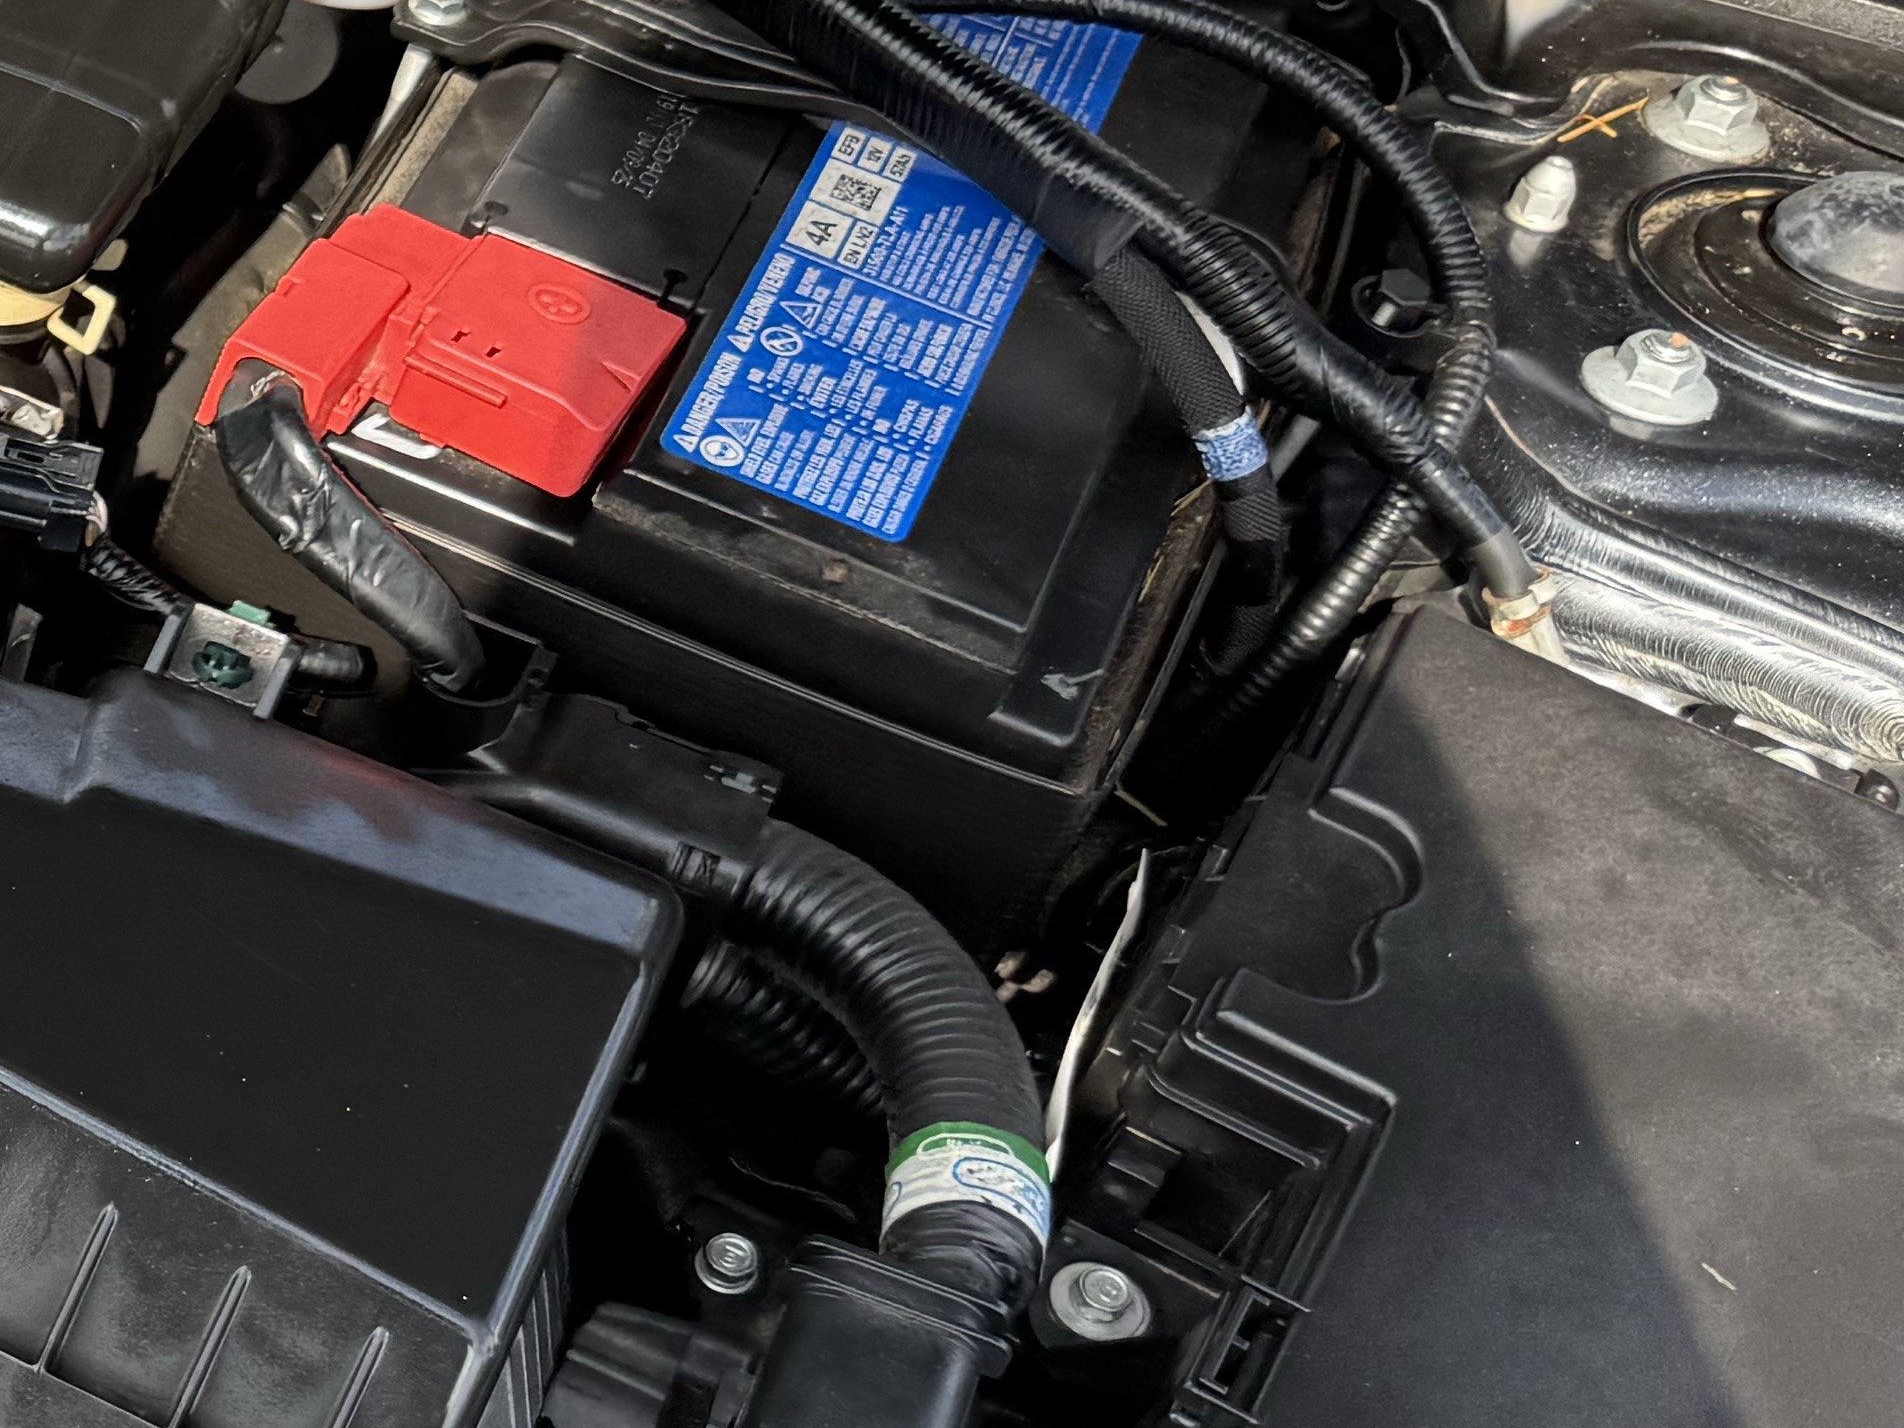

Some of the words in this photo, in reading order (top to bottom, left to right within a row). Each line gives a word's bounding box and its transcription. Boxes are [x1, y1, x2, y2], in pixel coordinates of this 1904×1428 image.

[837, 133, 860, 156] EFB
[800, 214, 838, 248] 4A
[843, 248, 862, 265] EN
[679, 351, 743, 436] DANGER/POISON
[733, 251, 798, 337] PELIGRO/VENENO
